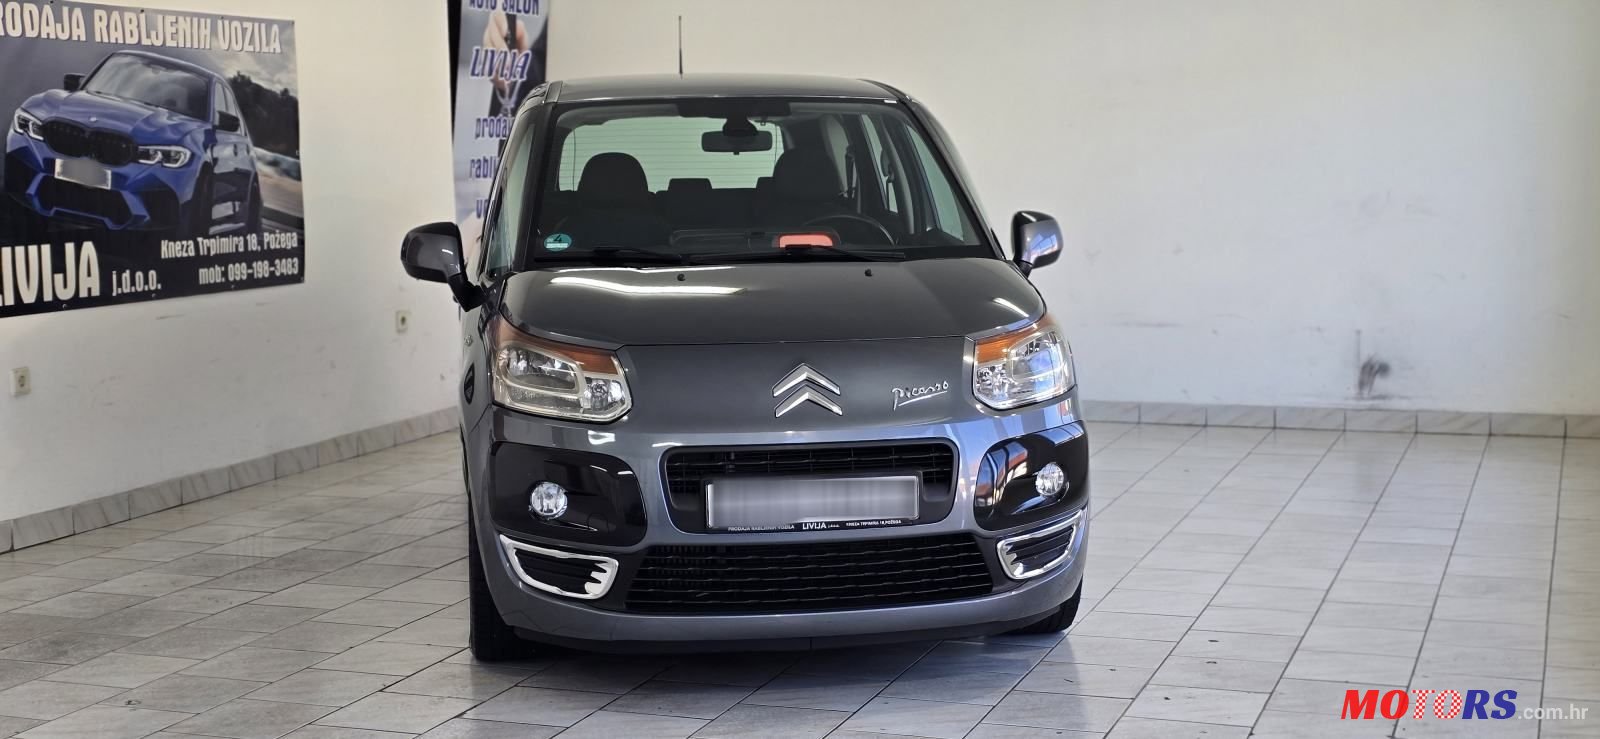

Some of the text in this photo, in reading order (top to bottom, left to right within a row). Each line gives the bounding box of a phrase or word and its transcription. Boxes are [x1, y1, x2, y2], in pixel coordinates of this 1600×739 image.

[502, 0, 539, 15] SALON
[94, 9, 211, 49] RABLJENIH
[218, 19, 281, 54] VOZILA
[470, 47, 532, 81] LIVIJA
[161, 239, 195, 259] Kneza
[197, 234, 244, 257] Trpimira
[264, 230, 298, 250] Požega
[0, 241, 162, 306] IVIJA j.d.o.o.
[199, 257, 299, 285] mob: 099-198-3483
[802, 522, 827, 530] LIVIJA
